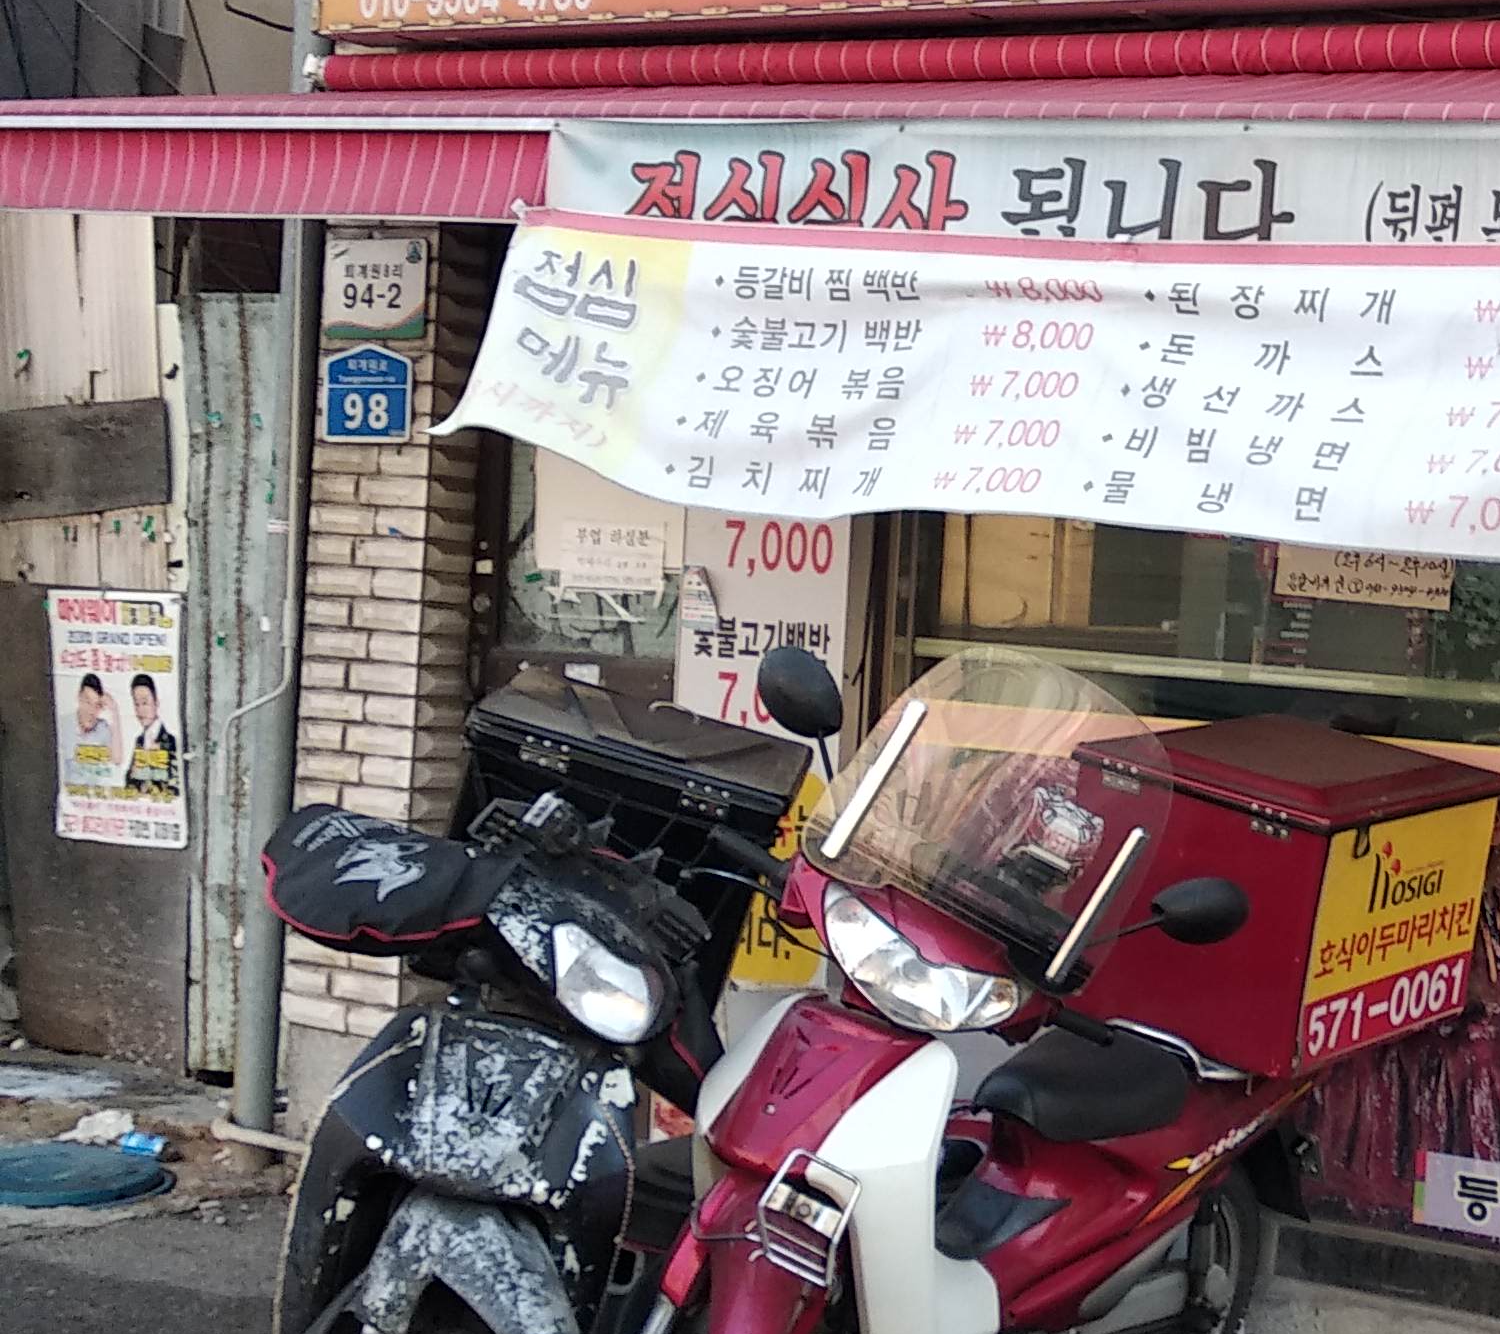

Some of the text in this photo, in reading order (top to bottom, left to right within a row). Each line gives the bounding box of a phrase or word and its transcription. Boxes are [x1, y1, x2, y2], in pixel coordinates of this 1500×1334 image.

[343, 282, 402, 310] 94-2
[513, 249, 639, 329] 점심
[733, 266, 812, 302] 등갈비
[730, 315, 848, 355] 숯불고기
[864, 318, 923, 354] 백반
[515, 327, 631, 411] 메뉴
[713, 365, 818, 400] 오징어
[840, 365, 906, 402] 볶음
[343, 392, 390, 431] 98
[725, 519, 834, 577] 7,000
[1314, 897, 1476, 979] 호식이두마리치킨
[1307, 957, 1466, 1057] 571-0061
